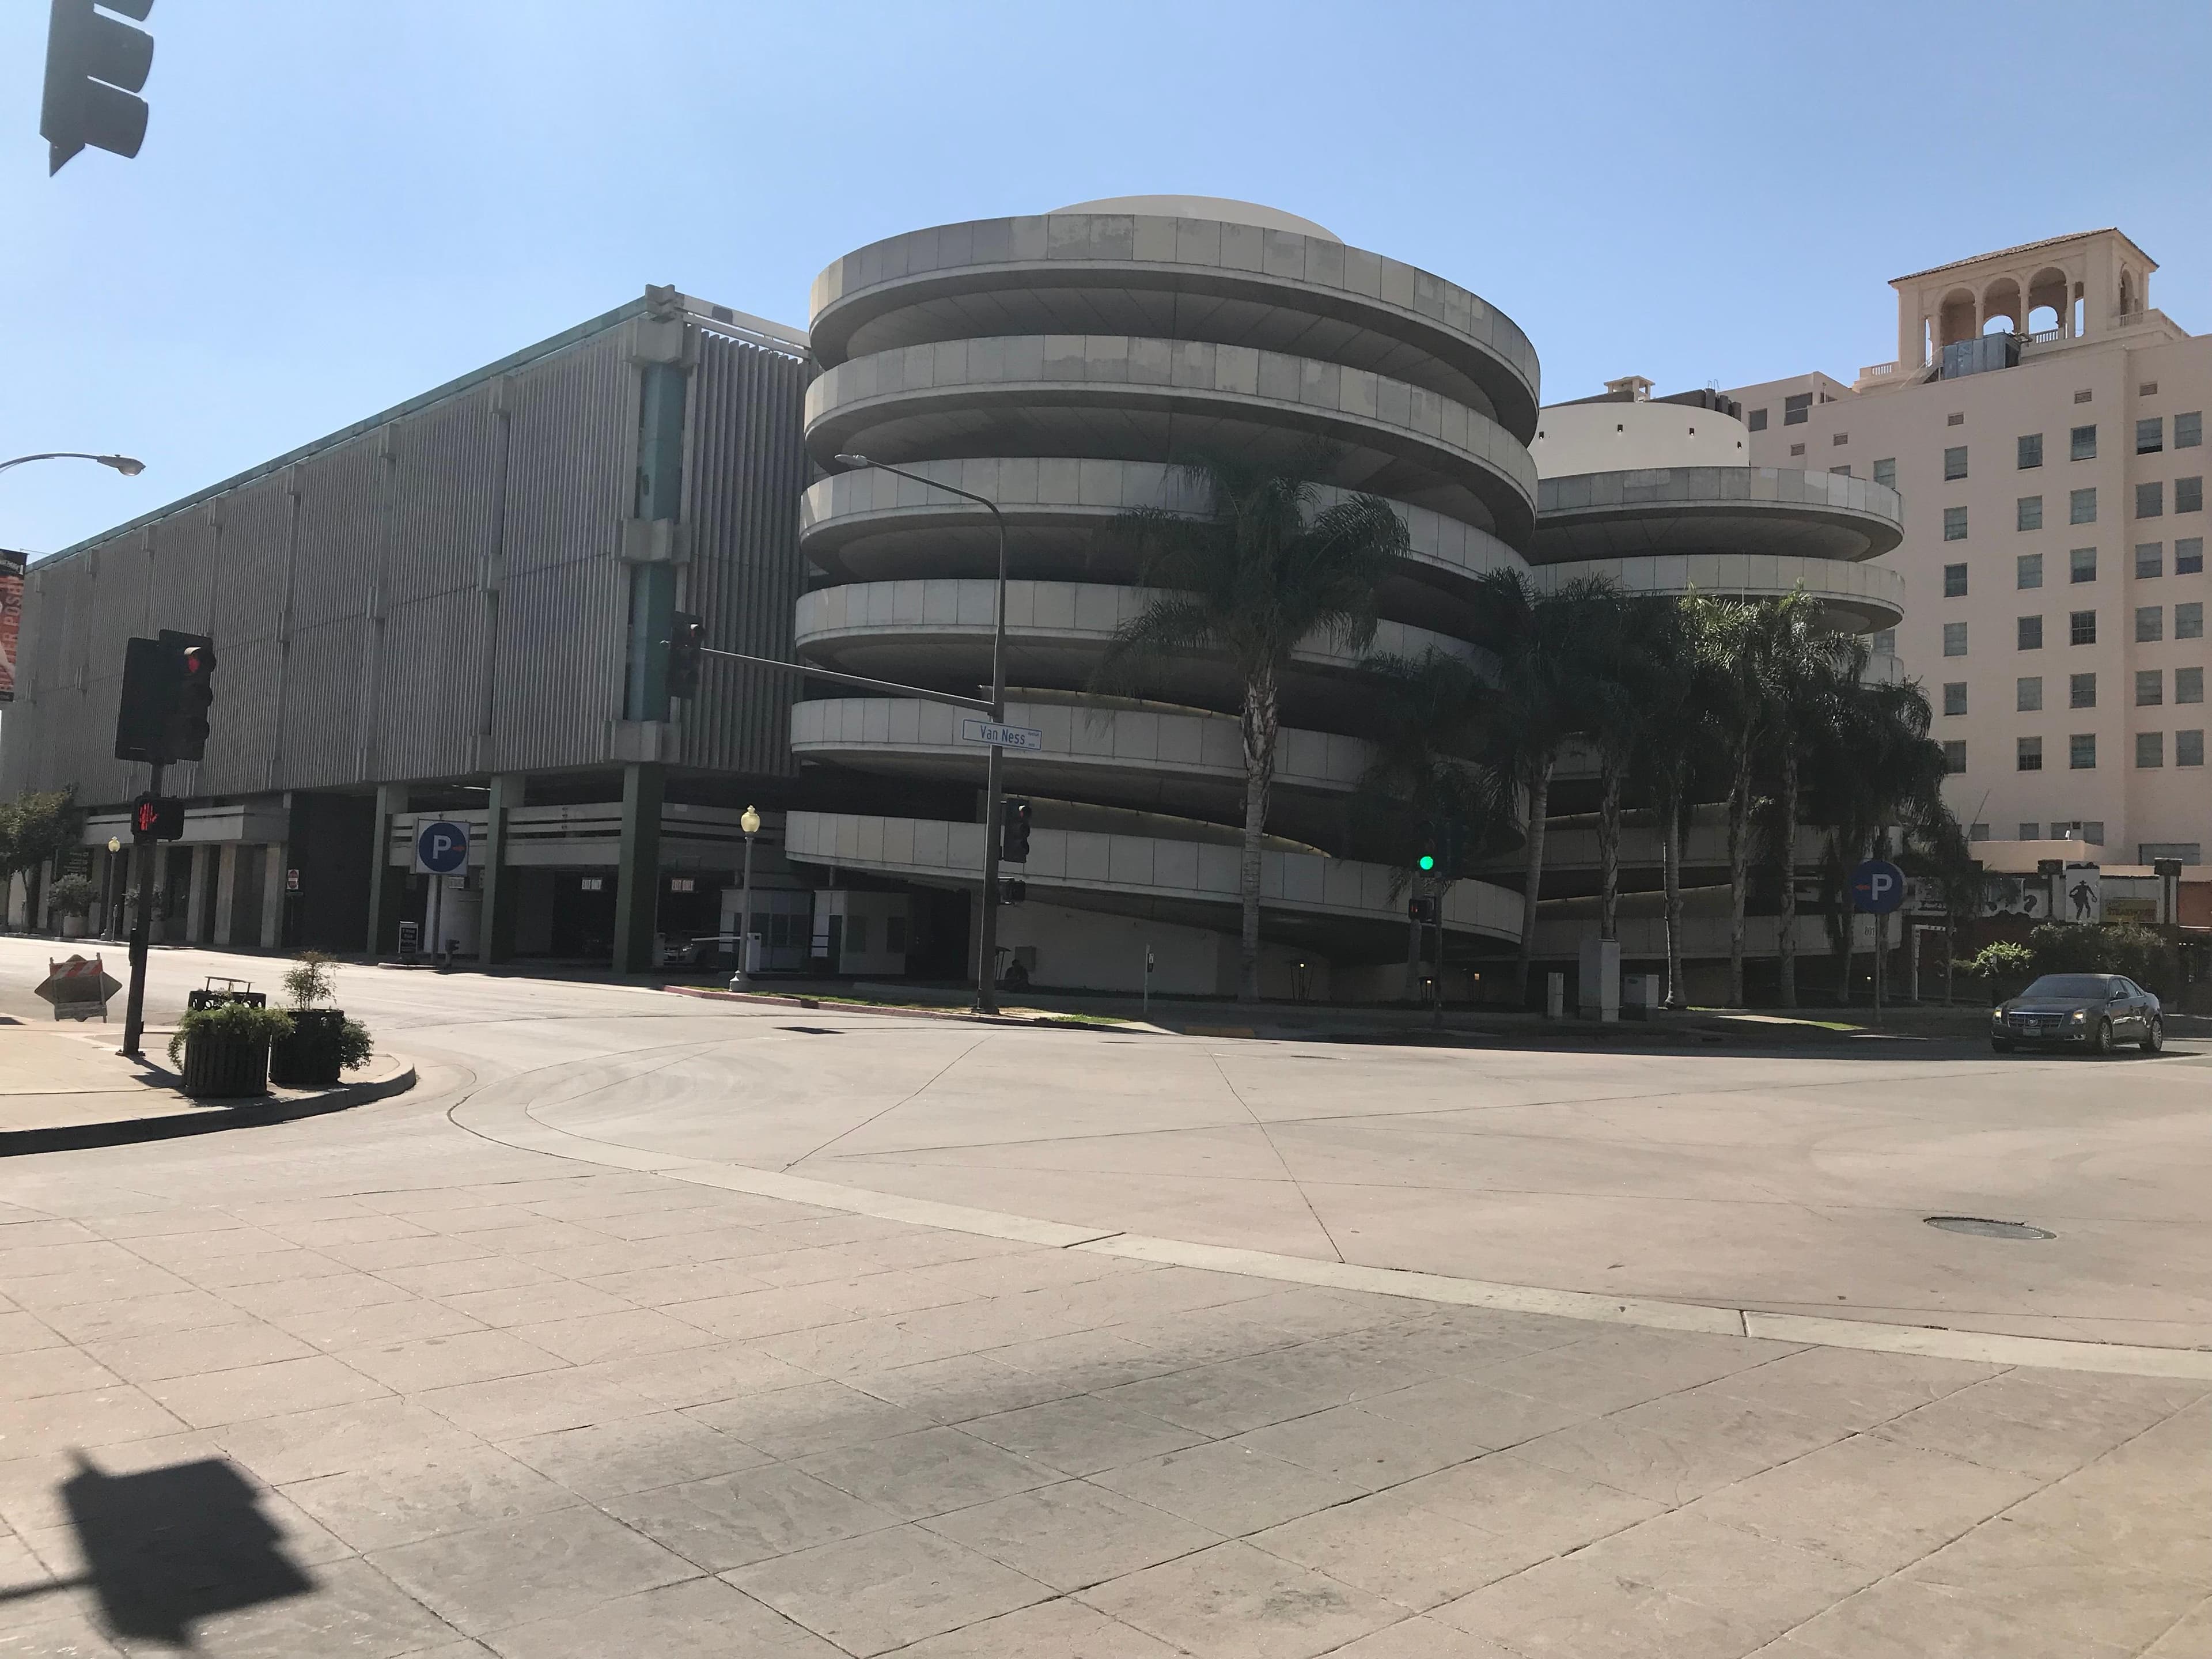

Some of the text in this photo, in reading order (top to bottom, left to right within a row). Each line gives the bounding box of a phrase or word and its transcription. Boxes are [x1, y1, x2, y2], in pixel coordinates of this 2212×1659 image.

[980, 725, 1025, 745] Van Ness
[433, 835, 452, 859] P
[672, 879, 682, 891] EXIT
[1872, 874, 1893, 900] P
